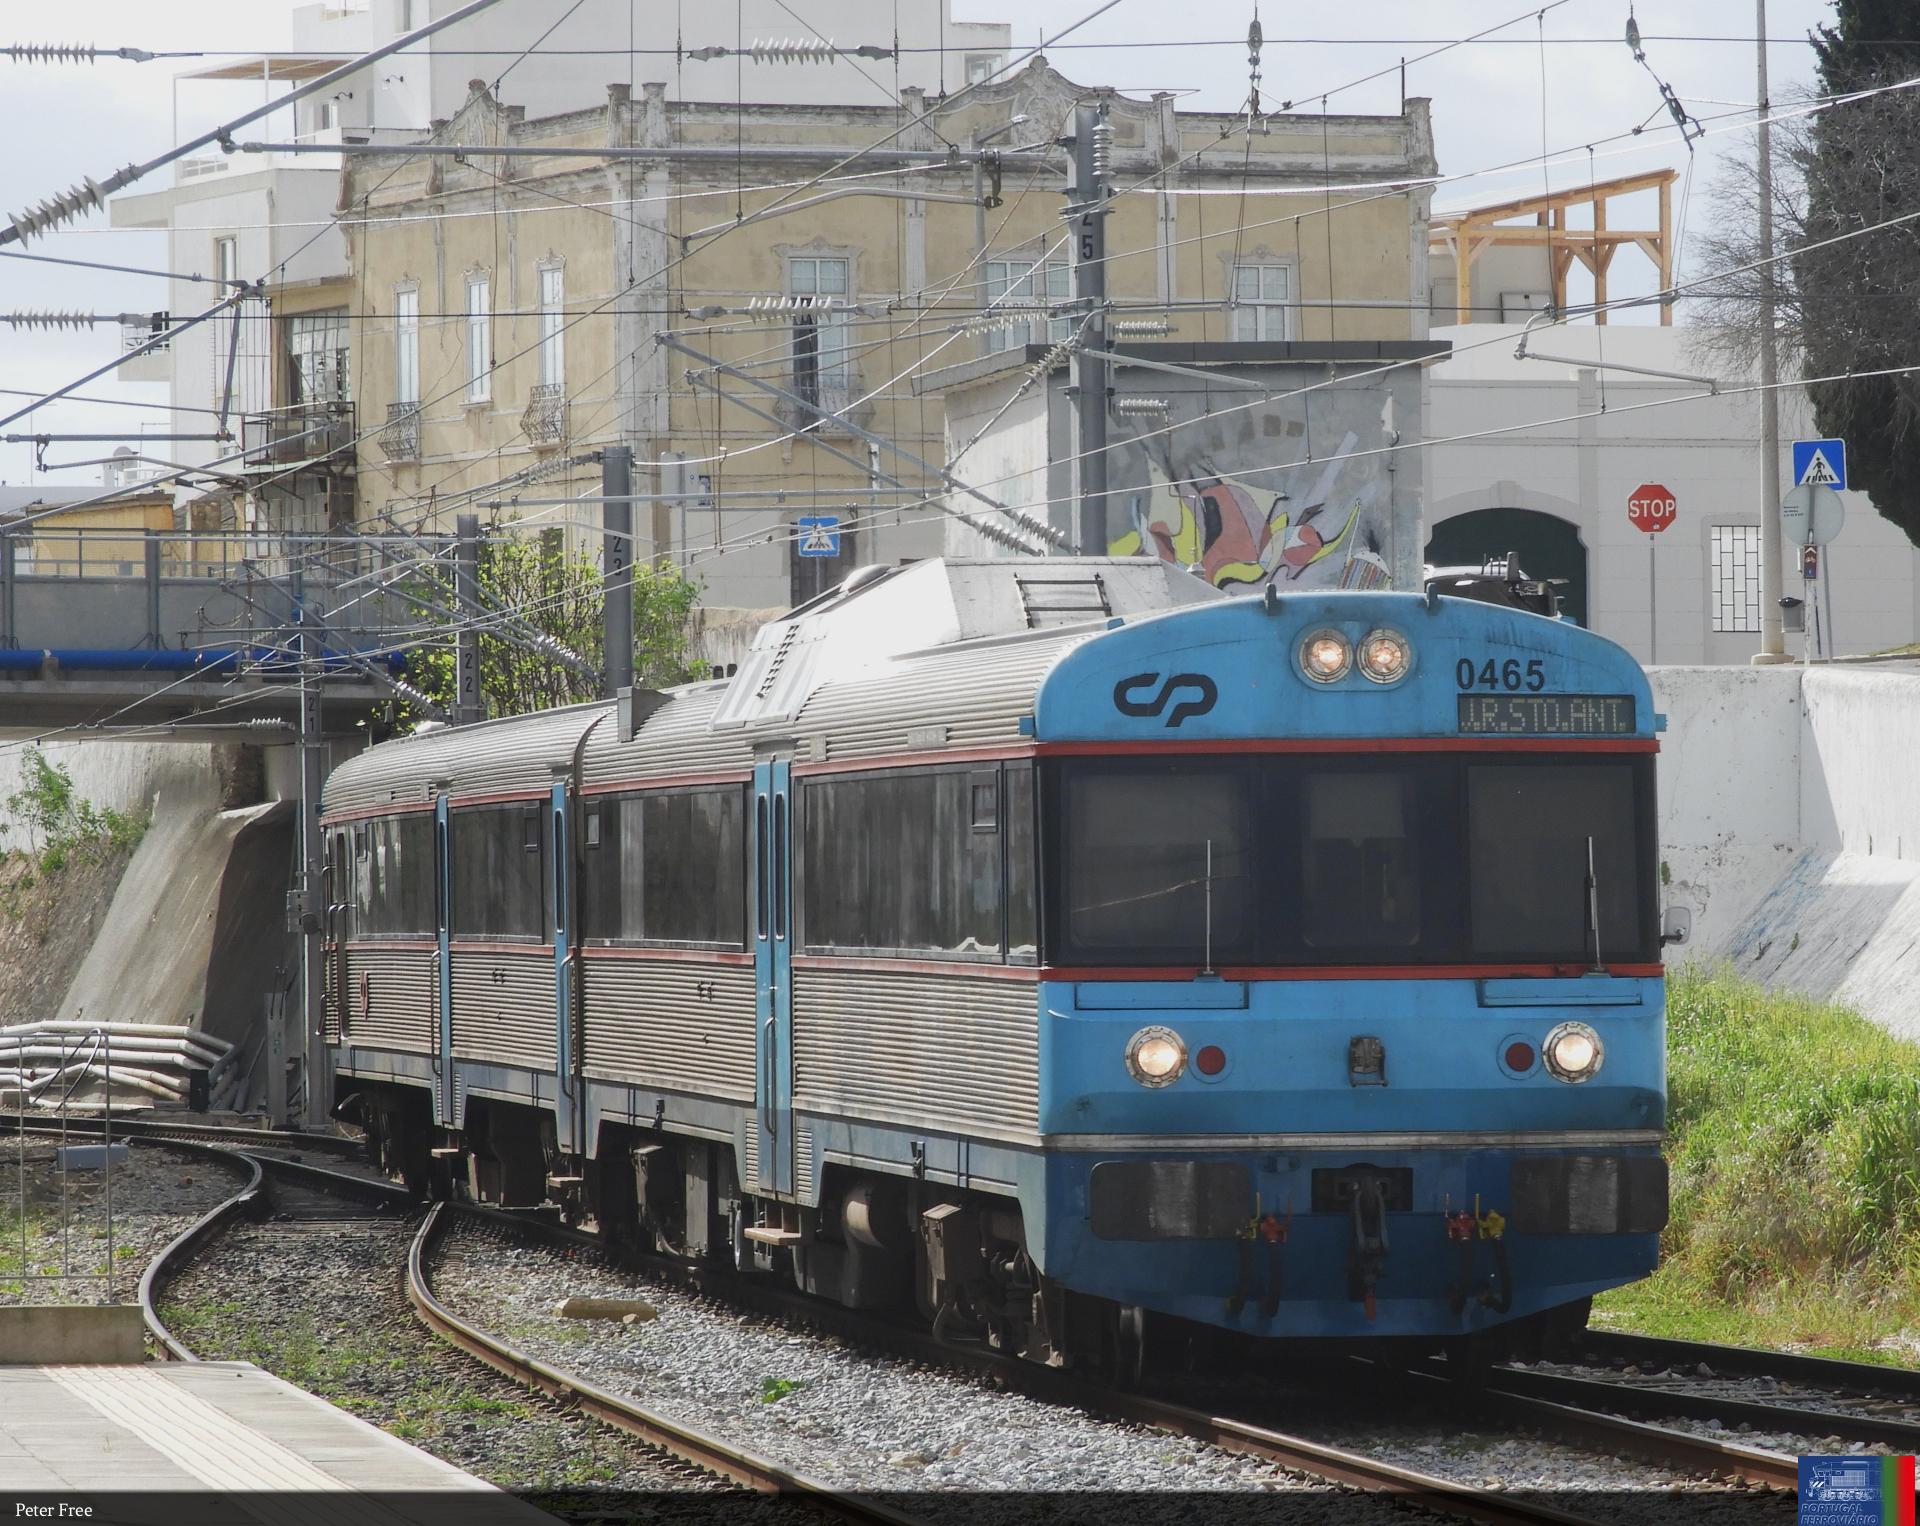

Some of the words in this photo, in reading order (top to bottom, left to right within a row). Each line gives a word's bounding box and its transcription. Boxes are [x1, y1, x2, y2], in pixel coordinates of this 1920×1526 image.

[1629, 499, 1675, 517] STOP
[465, 652, 474, 694] 22
[1456, 658, 1546, 691] 0465
